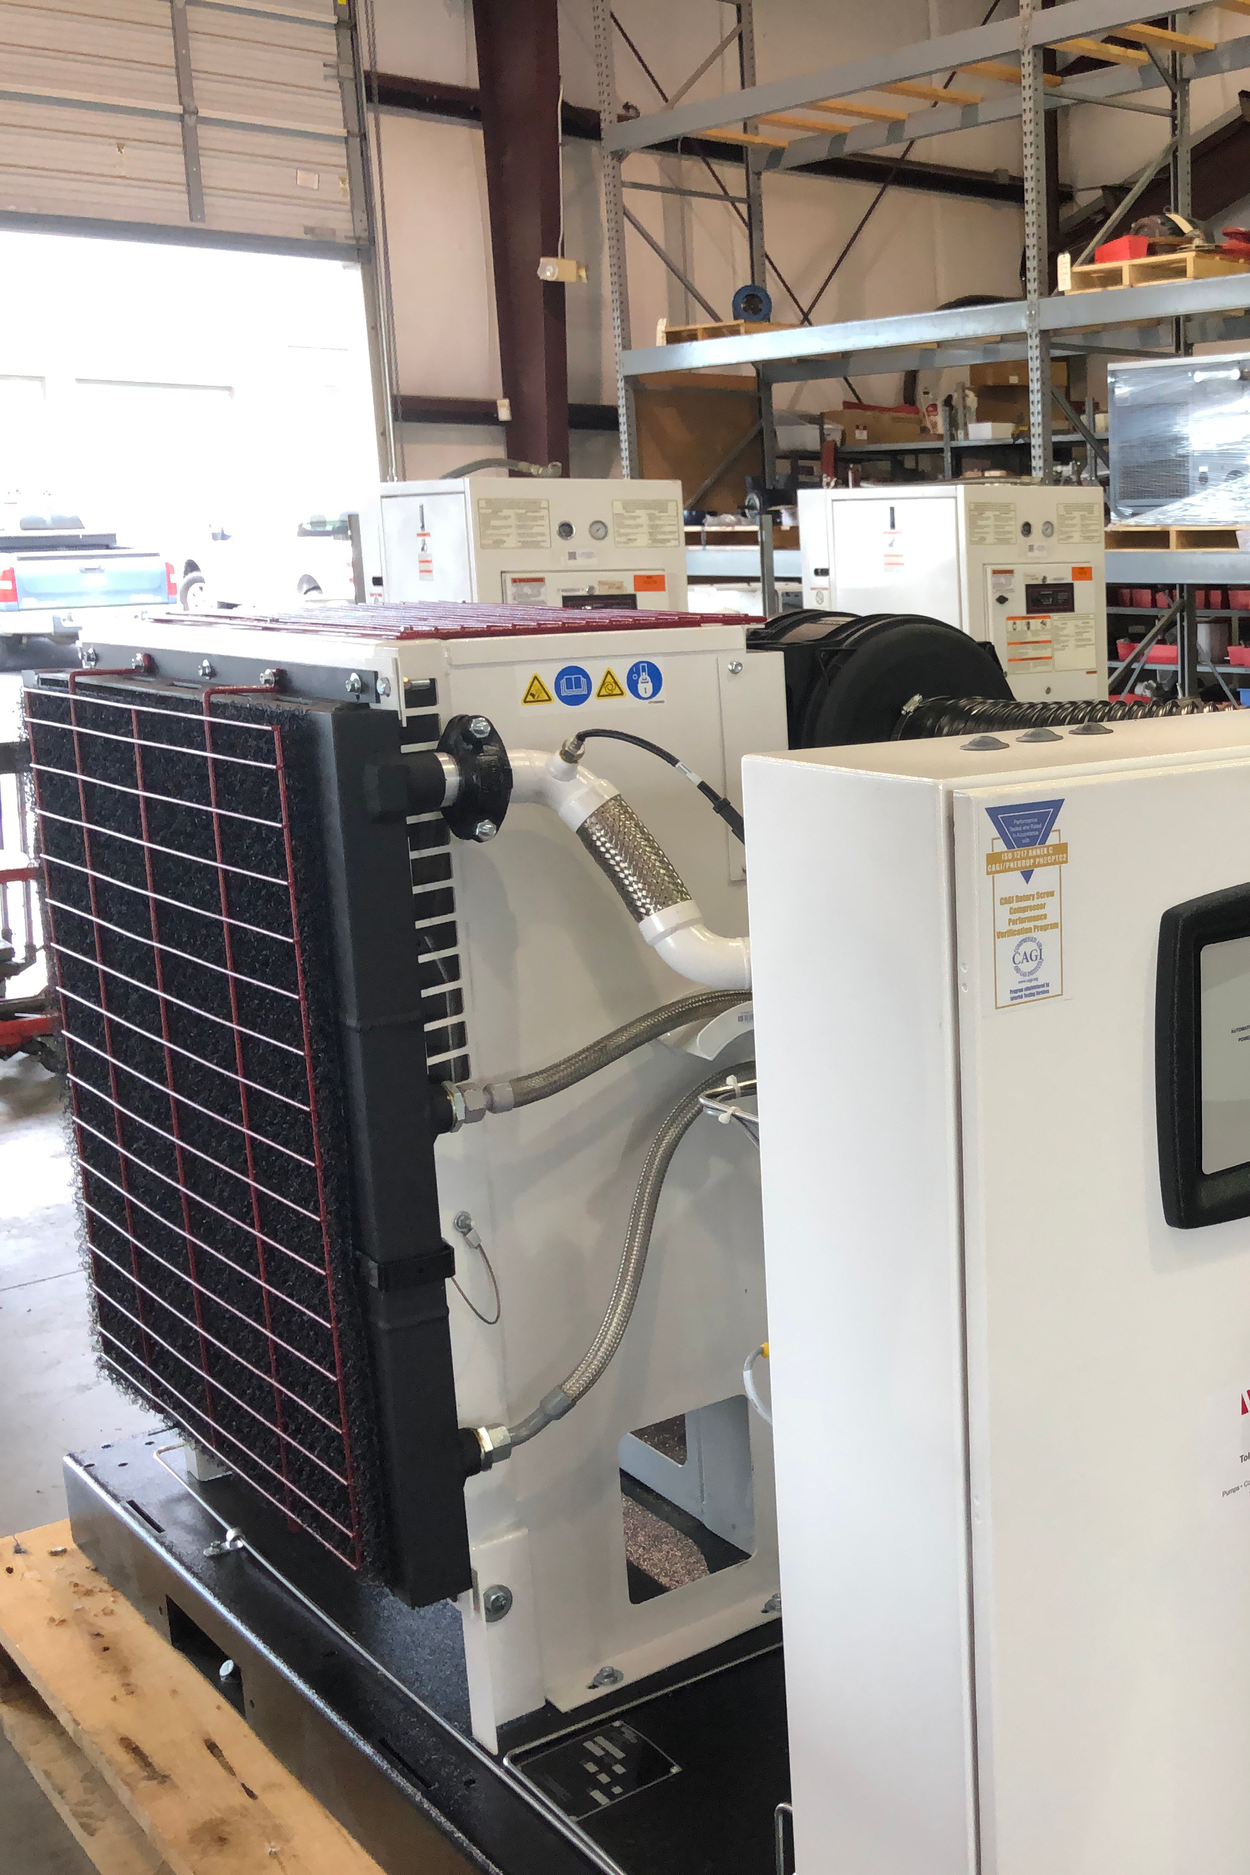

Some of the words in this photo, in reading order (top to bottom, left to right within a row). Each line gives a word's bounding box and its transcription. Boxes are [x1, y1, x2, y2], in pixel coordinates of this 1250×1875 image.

[1002, 852, 1012, 860] ISO
[1014, 851, 1027, 859] 1217
[1029, 848, 1047, 857] ANNEX
[1000, 896, 1014, 905] CAGI
[1015, 893, 1035, 903] Rotary
[1036, 890, 1055, 899] Screw
[1009, 902, 1046, 915] Compressor
[1008, 913, 1047, 926] Performance
[996, 926, 1032, 939] Verification
[1034, 922, 1059, 932] Program
[1012, 948, 1042, 965] CAGI
[1221, 1485, 1240, 1497] Pumps
